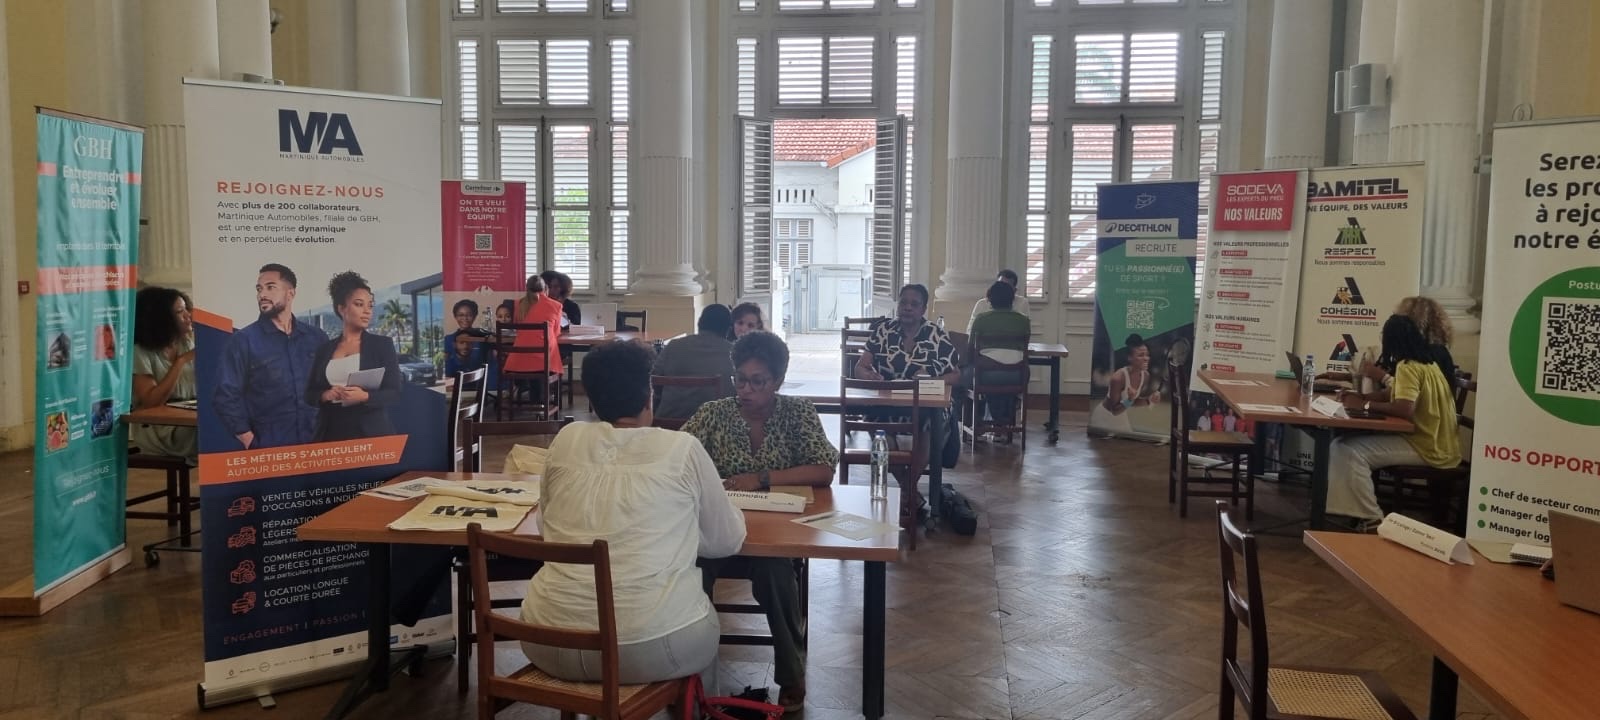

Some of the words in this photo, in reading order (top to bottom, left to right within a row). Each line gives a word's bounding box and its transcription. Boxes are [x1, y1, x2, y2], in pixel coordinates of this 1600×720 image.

[278, 109, 363, 156] MA
[73, 135, 113, 161] GBH
[279, 153, 319, 161] MARTINIQUE
[321, 155, 365, 164] AUTOMOBILES
[216, 181, 384, 199] REJOIGNEZ-NOUS
[1226, 183, 1285, 196] SODEVA
[1525, 177, 1558, 198] les
[217, 200, 239, 209] Avec
[242, 201, 262, 211] plus
[263, 202, 276, 210] de
[1224, 208, 1242, 221] NOS
[1244, 207, 1283, 221] VALEURS
[1353, 203, 1368, 211] DES
[1371, 202, 1408, 211] VALEURS
[1535, 203, 1548, 223] à
[218, 212, 265, 224] Martinique
[267, 213, 322, 223] Automobiles,
[324, 214, 345, 222] filiale
[359, 215, 381, 224] GBH,
[218, 224, 232, 232] est
[253, 225, 296, 234] entreprise
[298, 224, 346, 235] dynamique
[1118, 223, 1172, 233] DECATHLON
[218, 235, 228, 243] et
[244, 234, 293, 245] perpétuelle
[1135, 243, 1177, 252] RECRUTE
[1514, 231, 1579, 249] notre
[1324, 248, 1377, 256] RESPECT
[226, 457, 247, 467] LES
[250, 450, 297, 463] MÉTIERS
[299, 443, 374, 459] S'ARTICULENT
[1484, 444, 1522, 463] NOS
[226, 467, 270, 478] AUTOUR
[272, 463, 291, 473] DES
[294, 457, 343, 470] ACTIVITÉS
[344, 451, 396, 465] SUIVANTES
[261, 492, 292, 503] VENTE
[294, 489, 307, 499] DE
[309, 482, 357, 497] VÉHICULES
[1491, 487, 1515, 500] Chef
[1516, 492, 1529, 503] de
[1531, 496, 1571, 510] secteur
[261, 498, 324, 514] D'OCCASIONS
[1490, 504, 1533, 521] Manager
[1535, 513, 1548, 524] de
[262, 527, 298, 540] LÉGERS
[1489, 521, 1532, 538] Manager
[1534, 530, 1550, 543] log
[263, 544, 358, 564] COMMERCIALISATION
[263, 563, 277, 574] DE
[278, 558, 310, 572] PIÈCES
[312, 556, 324, 566] DE
[326, 550, 370, 563] RECHANG
[276, 567, 313, 579] particuliers
[264, 583, 311, 598] LOCATION
[312, 576, 350, 590] LONGUE
[264, 600, 271, 608] &
[273, 593, 311, 606] COURTE
[311, 586, 342, 599] DURÉE
[223, 623, 300, 645] ENGAGEMENT
[312, 611, 357, 627] PASSION
